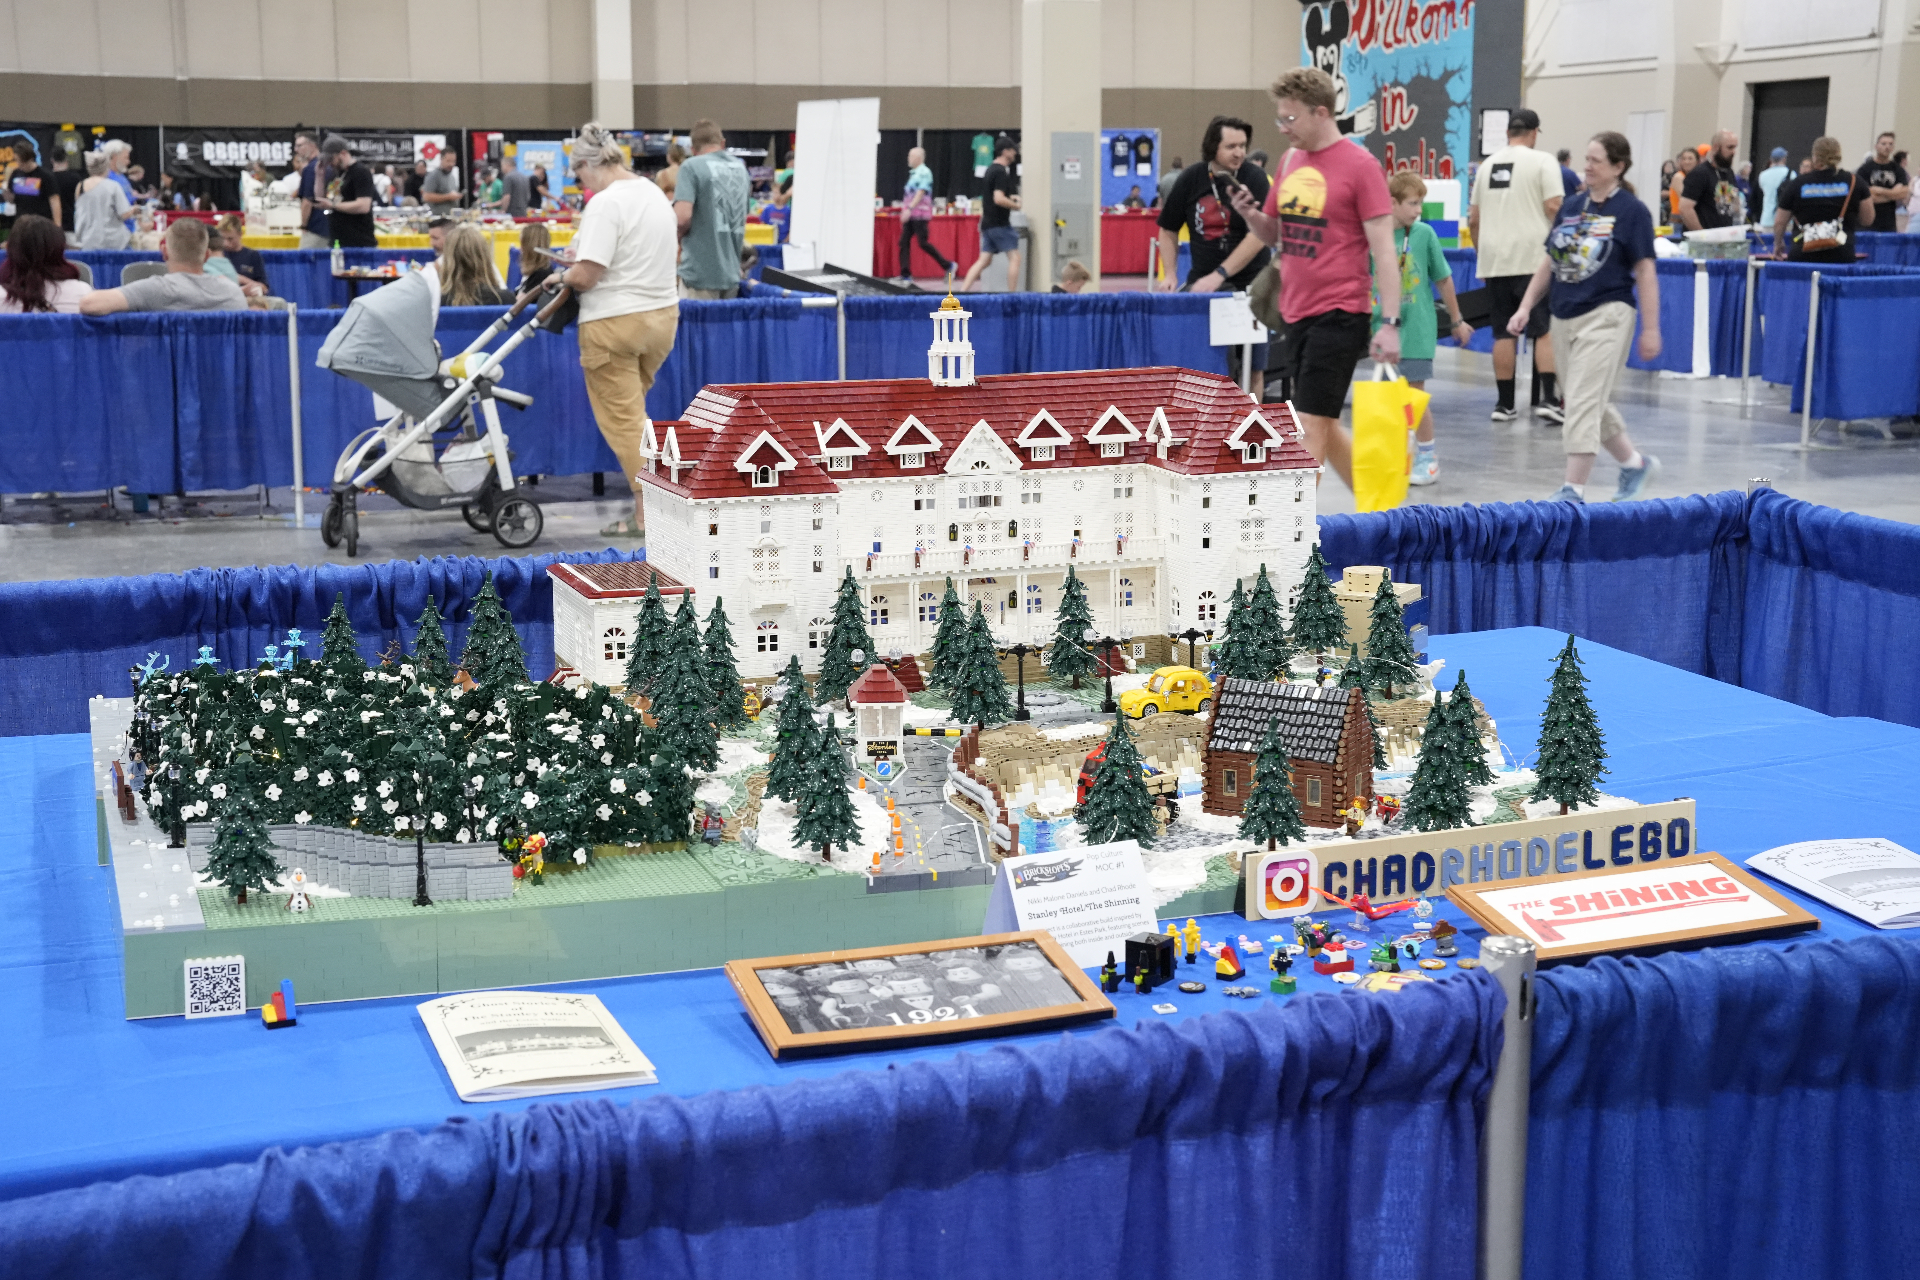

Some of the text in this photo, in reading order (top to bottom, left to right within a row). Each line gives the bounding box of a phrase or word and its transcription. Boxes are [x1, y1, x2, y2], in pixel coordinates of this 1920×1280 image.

[1382, 84, 1417, 133] in
[867, 742, 897, 755] Stanley
[1100, 850, 1124, 858] Culture
[1023, 862, 1070, 881] BRICKSLOPES
[1096, 862, 1114, 872] MOC
[1044, 894, 1065, 903] Malone
[1066, 890, 1088, 899] Daniels
[1101, 886, 1116, 894] Chad
[1117, 882, 1136, 891] Rhode
[1028, 909, 1058, 920] Stanley
[1104, 897, 1140, 908] Shinning
[1508, 900, 1544, 911] THE
[1066, 919, 1099, 930] collaborative
[1114, 912, 1134, 922] inspired
[885, 1004, 983, 1026] 1921
